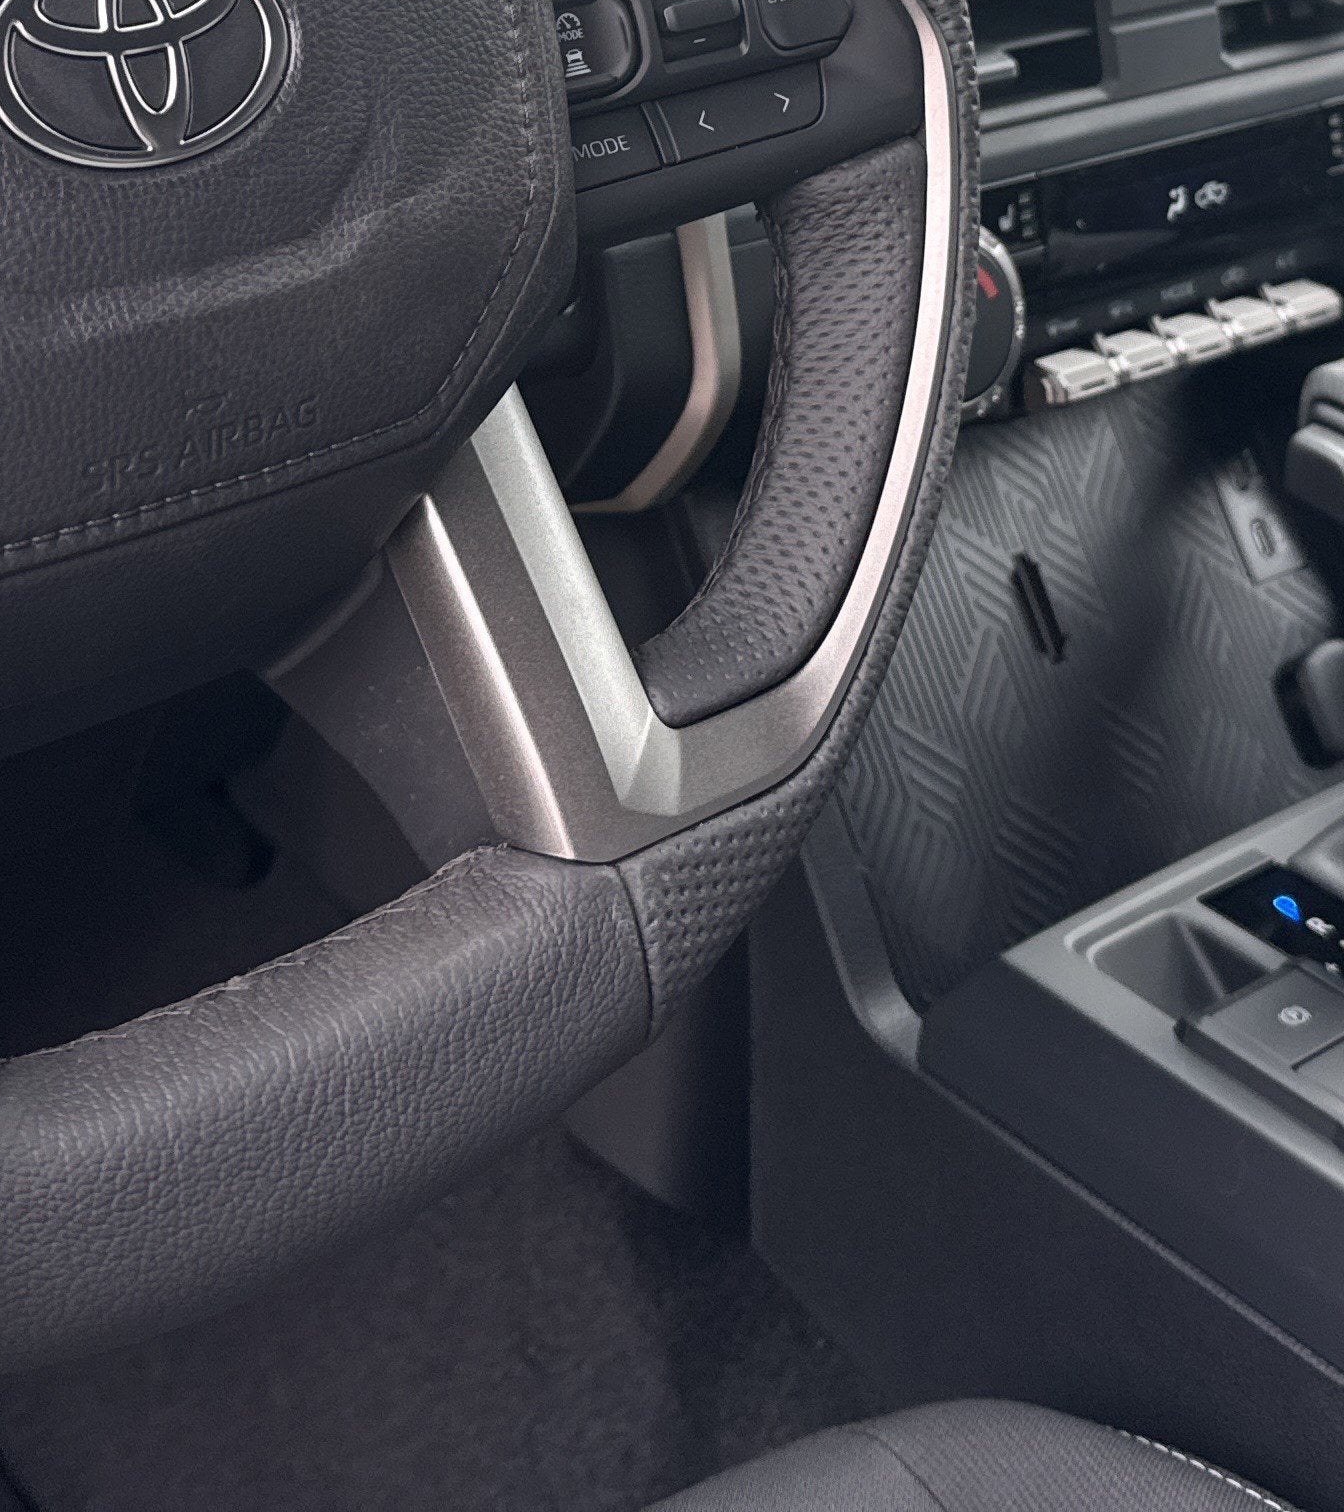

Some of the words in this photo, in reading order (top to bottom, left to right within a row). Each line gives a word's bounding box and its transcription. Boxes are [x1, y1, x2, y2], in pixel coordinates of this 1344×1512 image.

[559, 28, 584, 42] MODE
[572, 134, 631, 162] MODE
[1306, 917, 1337, 937] R
